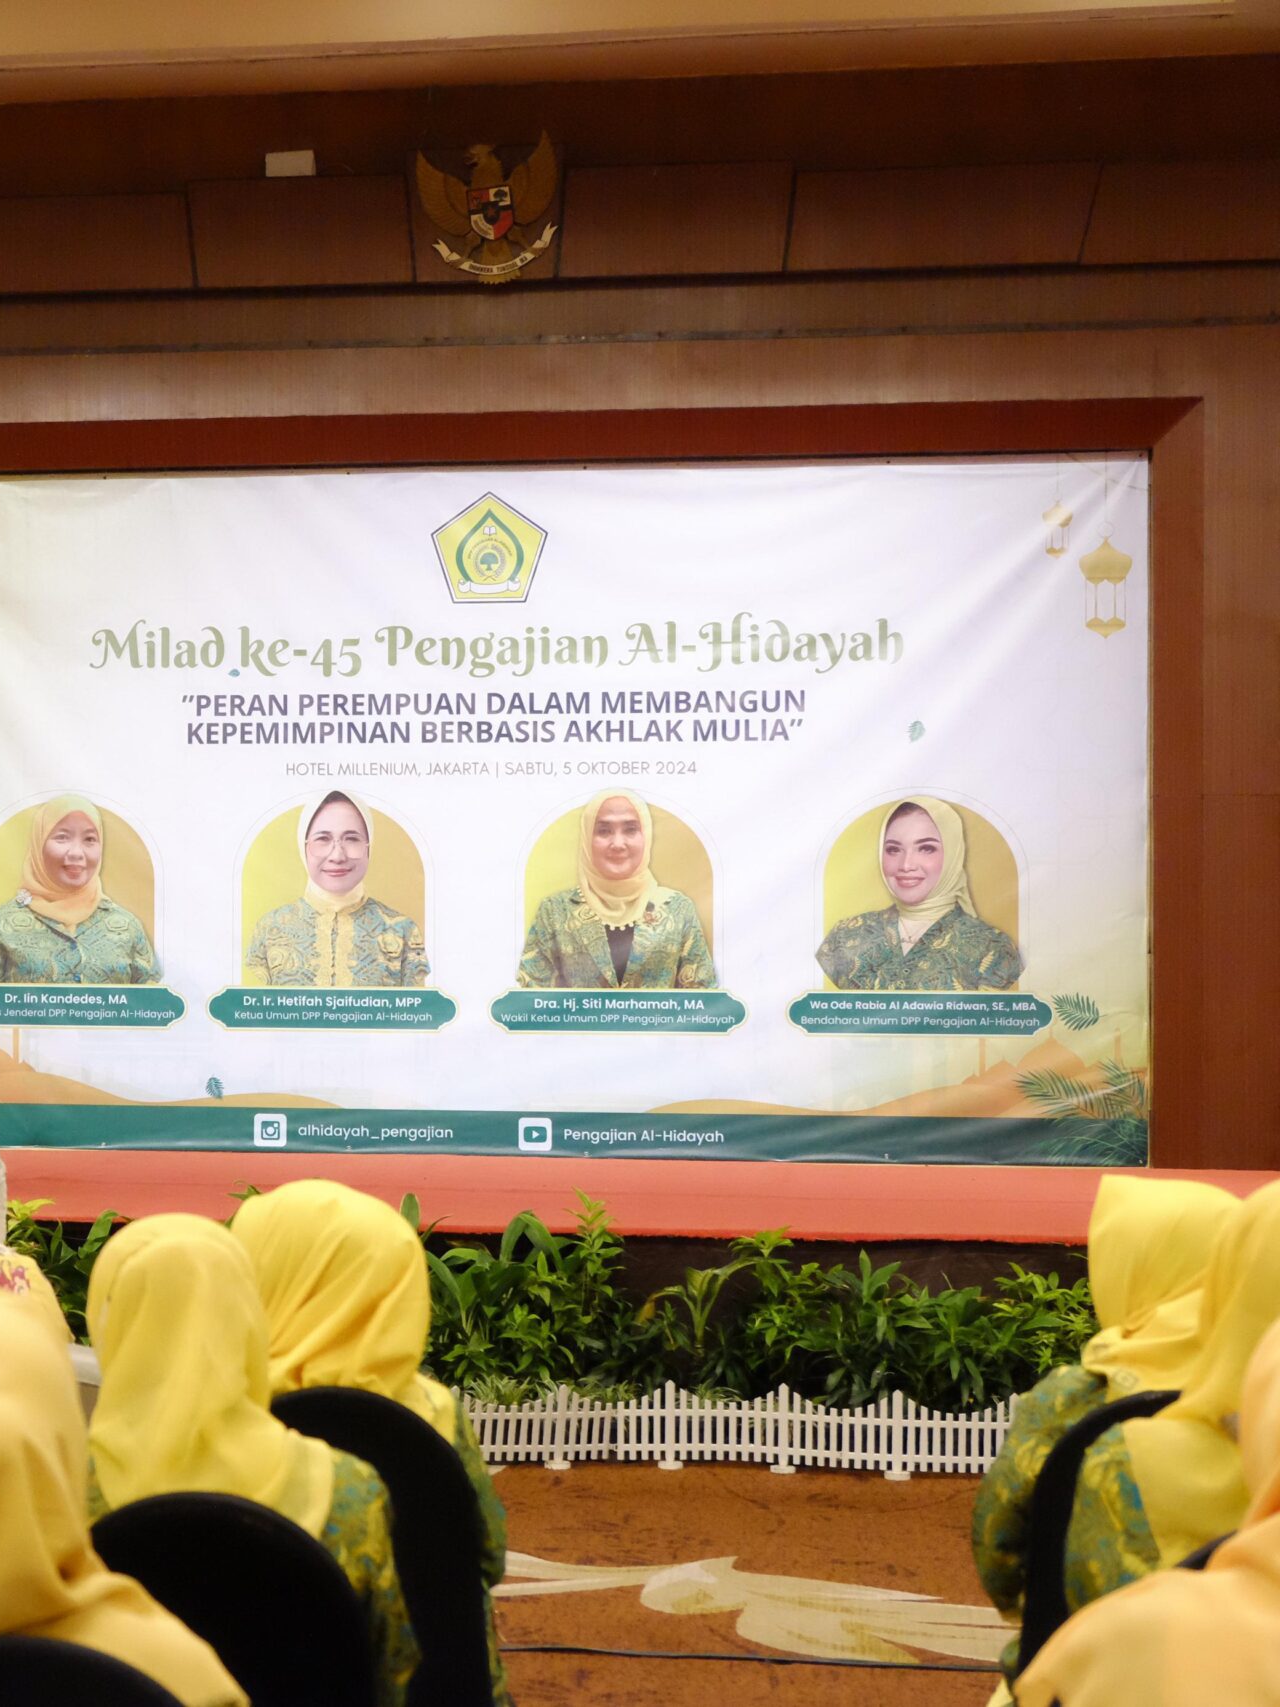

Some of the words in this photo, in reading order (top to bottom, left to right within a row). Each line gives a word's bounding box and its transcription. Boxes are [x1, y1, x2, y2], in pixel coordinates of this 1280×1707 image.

[90, 620, 225, 669] Milad
[238, 626, 362, 678] ke-45
[375, 626, 608, 678] Pengajian
[619, 612, 902, 674] Al-Hidayah
[299, 693, 475, 716] PEREMPUAN
[487, 692, 589, 714] DALAM
[602, 690, 805, 713] MEMBANGUN
[188, 722, 410, 744] KEPEMIMPINAN
[422, 721, 555, 743] BERBASIS
[564, 720, 683, 742] AKHLAK
[286, 763, 333, 775] HOTEL
[338, 763, 421, 776] MILLENIUM,
[426, 762, 489, 775] JAKARTA
[505, 762, 557, 776] SABTU,
[563, 762, 571, 775] 5
[577, 761, 650, 775] OKTOBER
[656, 761, 696, 774] 2024
[4, 993, 22, 1004] Dr.
[40, 993, 106, 1006] Kandedes,
[108, 994, 128, 1005] MA
[243, 995, 260, 1006] Dr.
[262, 995, 275, 1006] Ir.
[277, 995, 323, 1007] Hetifah
[325, 995, 393, 1010] Sjaifudian,
[395, 996, 422, 1008] MPP
[534, 997, 560, 1009] Dra.
[563, 997, 580, 1012] Hj.
[581, 997, 602, 1009] Siti
[605, 998, 681, 1011] Marhamah,
[684, 999, 705, 1010] MA
[809, 1000, 829, 1010] Wa
[829, 1000, 853, 1010] Ode
[854, 1000, 887, 1010] Rabia
[888, 1000, 900, 1010] Al
[901, 1000, 944, 1011] Adawia
[945, 1000, 990, 1012] Ridwan,
[1012, 1001, 1037, 1011] MBA
[3, 1007, 47, 1017] Jenderal
[48, 1008, 67, 1018] DPP
[68, 1008, 118, 1021] Pengajian
[119, 1009, 176, 1021] Al-Hidayah
[234, 1010, 264, 1020] Ketua
[265, 1011, 300, 1020] Umum
[301, 1011, 321, 1021] DPP
[322, 1011, 374, 1023] Pengajian
[375, 1011, 433, 1024] Al-Hidayah
[500, 1013, 528, 1023] Wakil
[530, 1013, 561, 1023] Ketua
[562, 1014, 599, 1023] Umum
[600, 1014, 621, 1023] DPP
[622, 1014, 675, 1027] Pengajian
[676, 1014, 736, 1028] Al-Hidayah
[800, 1015, 861, 1026] Bendahara
[862, 1016, 899, 1026] Umum
[900, 1015, 922, 1026] DPP
[923, 1016, 977, 1029] Pengajian
[979, 1017, 1041, 1029] Al-Hidayah
[298, 1124, 453, 1141] alhidayah_pengajian
[564, 1129, 636, 1144] Pengajian
[641, 1130, 724, 1145] Al-Hidayah
